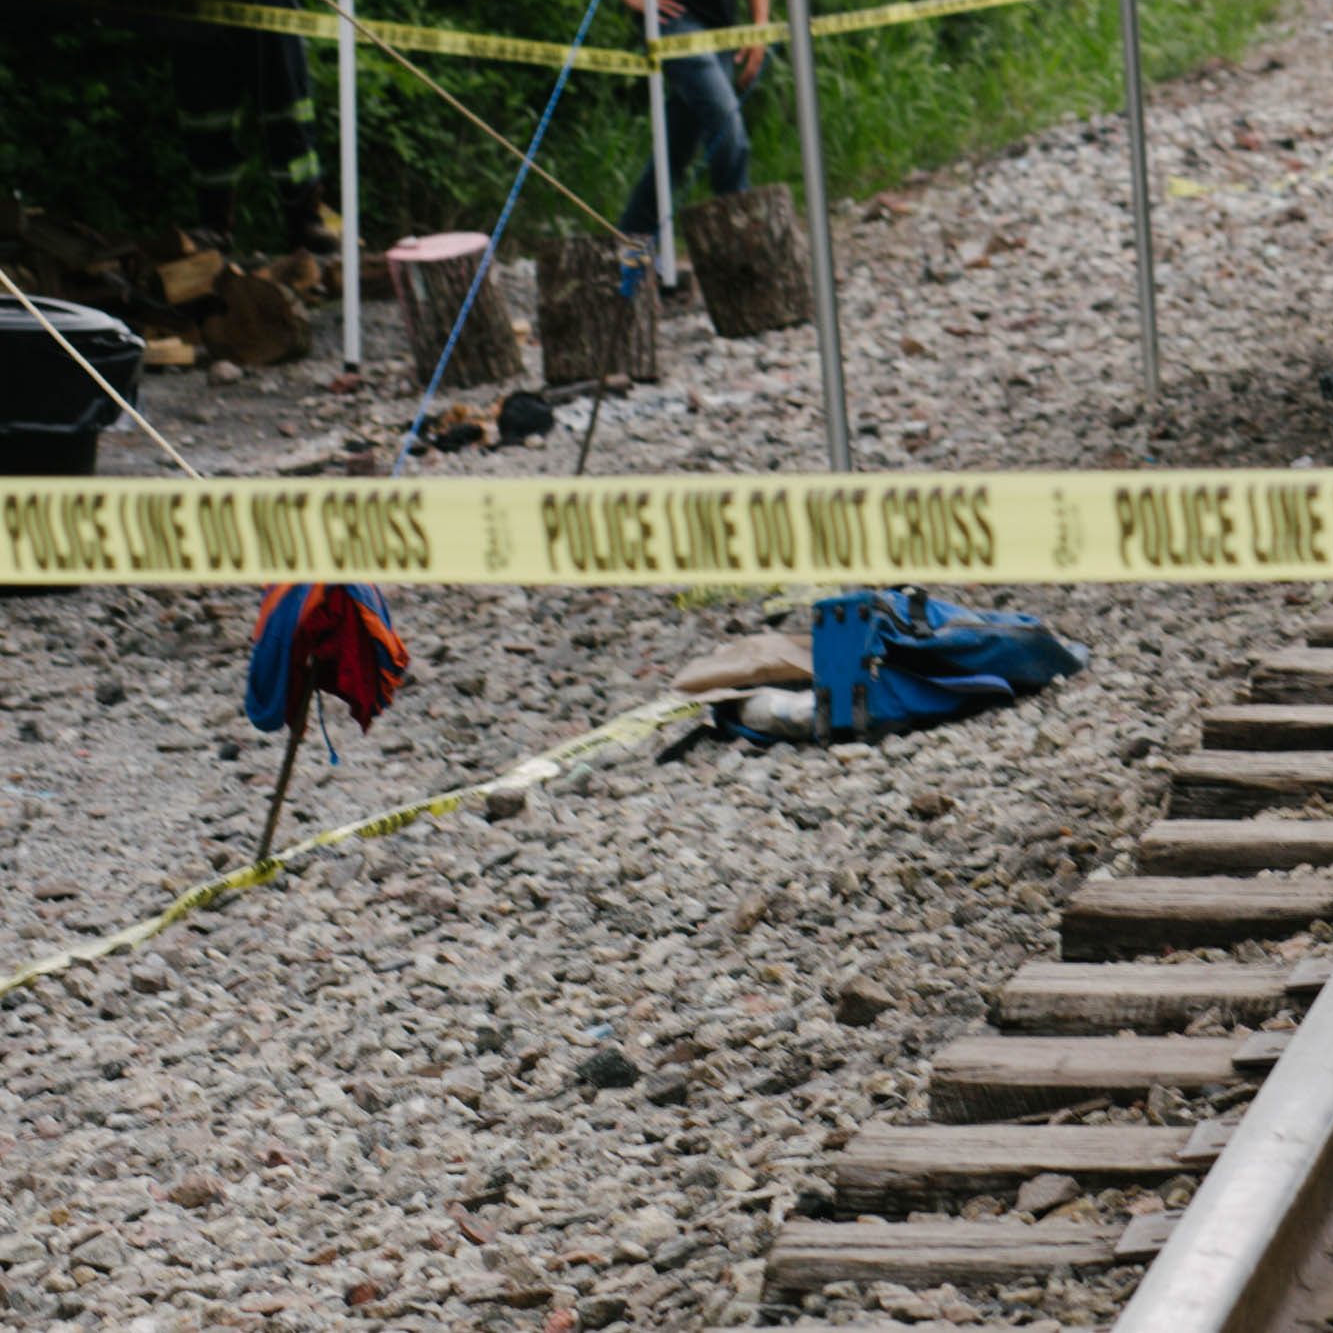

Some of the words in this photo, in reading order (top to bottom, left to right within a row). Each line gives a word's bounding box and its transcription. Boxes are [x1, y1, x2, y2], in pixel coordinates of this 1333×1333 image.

[3, 493, 117, 570] POLICE
[118, 493, 193, 571] LINE
[198, 493, 244, 570] DO
[250, 492, 313, 571] NOT
[321, 490, 430, 570] CROSS
[541, 492, 658, 572] POLICE
[664, 491, 741, 570] LINE
[748, 489, 795, 570] DO
[804, 488, 869, 569] NOT
[881, 486, 994, 568] CROSS
[1114, 485, 1238, 567] POLICE
[1247, 484, 1326, 564] LINE
